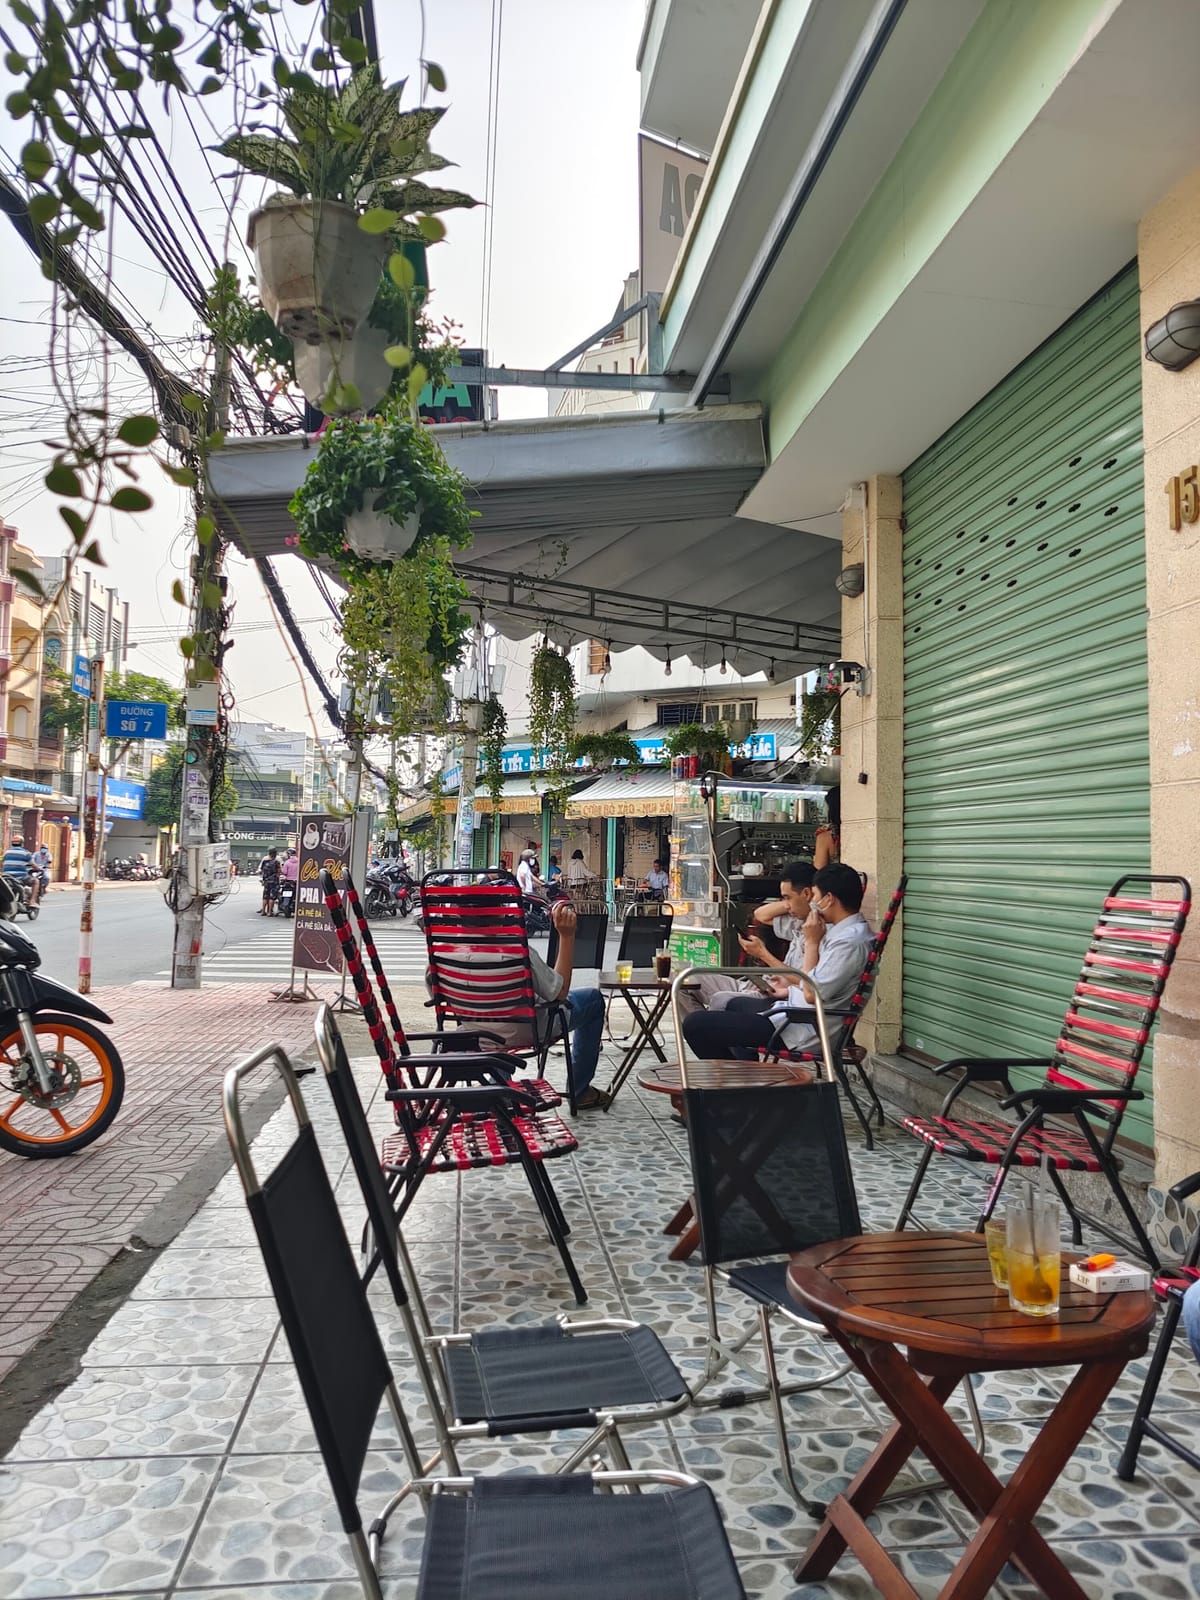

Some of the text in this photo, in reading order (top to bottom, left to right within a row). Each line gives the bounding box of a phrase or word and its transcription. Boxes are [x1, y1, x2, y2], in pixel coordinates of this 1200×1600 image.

[120, 704, 154, 717] ĐƯỜNG
[120, 717, 152, 732] SỐ 7
[301, 858, 319, 882] Cà
[300, 887, 320, 904] PHA
[298, 907, 305, 917] CÀ
[305, 908, 315, 917] PHÊ
[297, 920, 304, 929] CÀ
